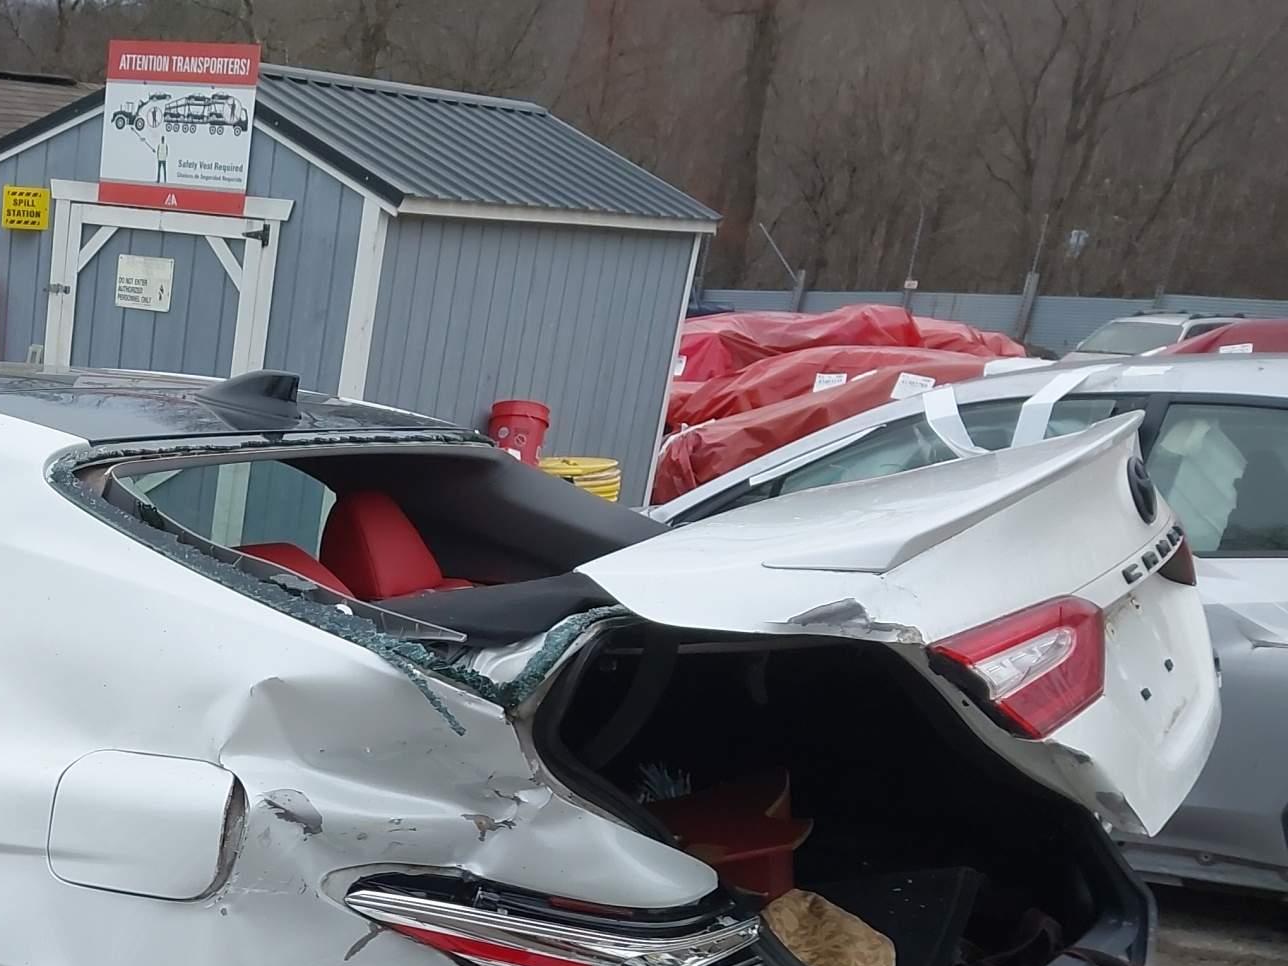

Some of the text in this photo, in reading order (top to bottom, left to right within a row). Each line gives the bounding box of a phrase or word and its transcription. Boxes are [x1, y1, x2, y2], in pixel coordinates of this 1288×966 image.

[119, 54, 251, 76] ATTENTION TRANSPORTERS!
[178, 160, 244, 173] Safety Vest Required
[13, 199, 36, 208] SPILL
[6, 209, 41, 218] STATION
